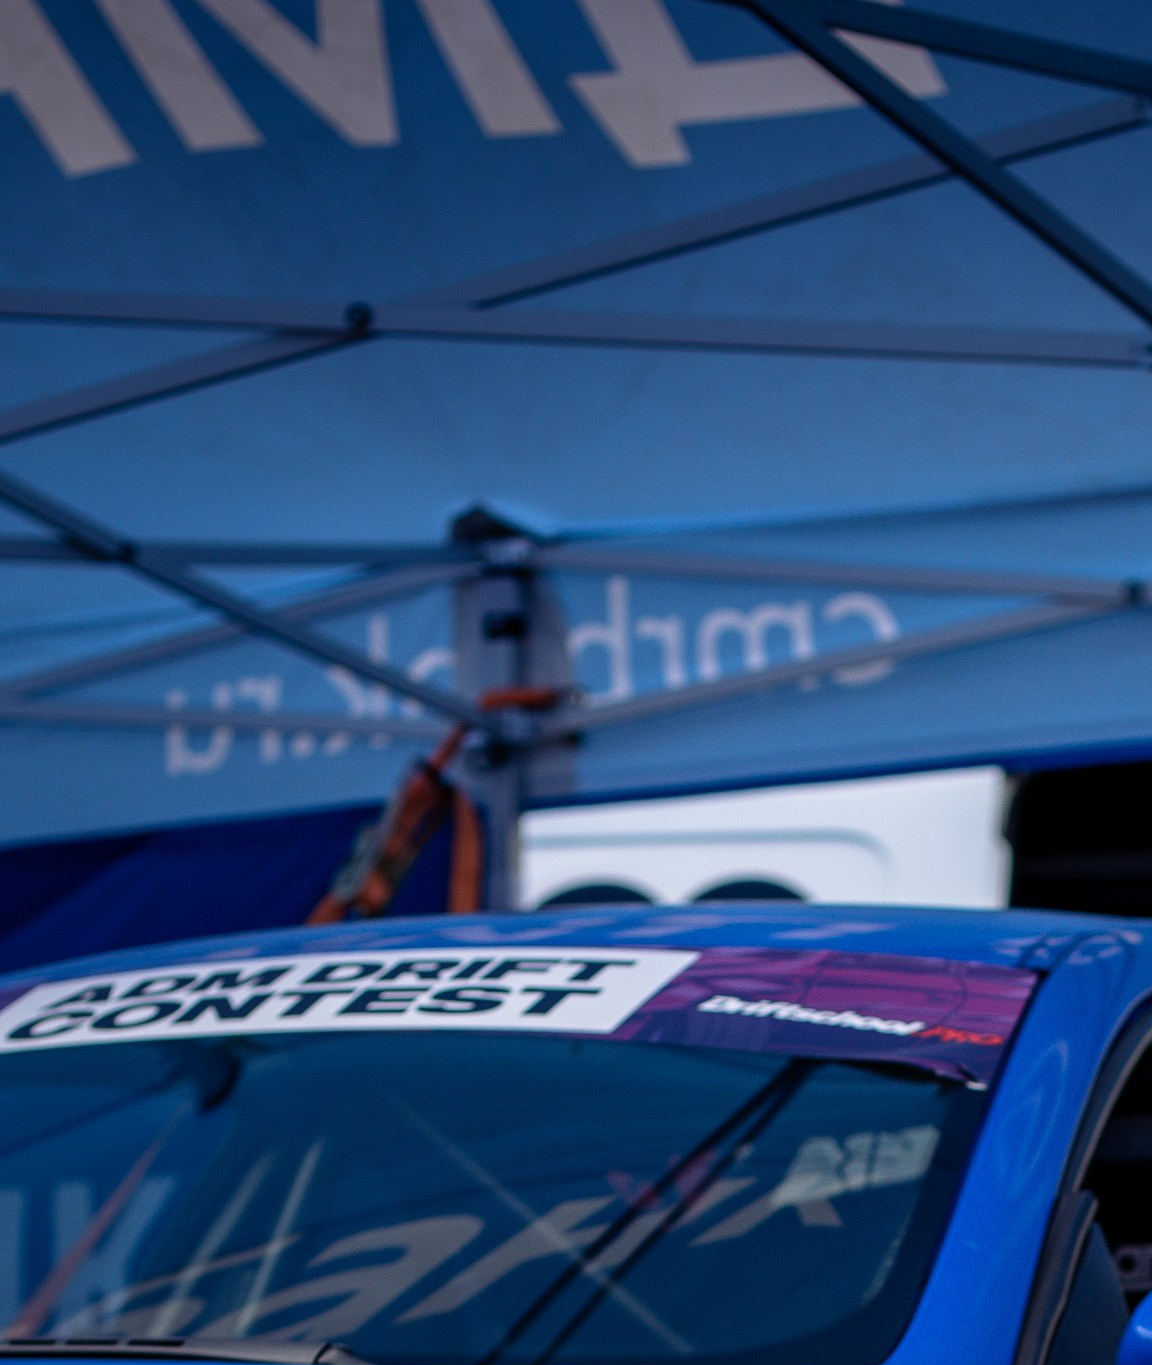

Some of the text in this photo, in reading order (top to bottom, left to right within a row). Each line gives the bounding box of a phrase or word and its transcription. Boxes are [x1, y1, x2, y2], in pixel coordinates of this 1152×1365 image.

[49, 957, 637, 1009] ADM DRIFT
[5, 986, 607, 1041] CONTEST
